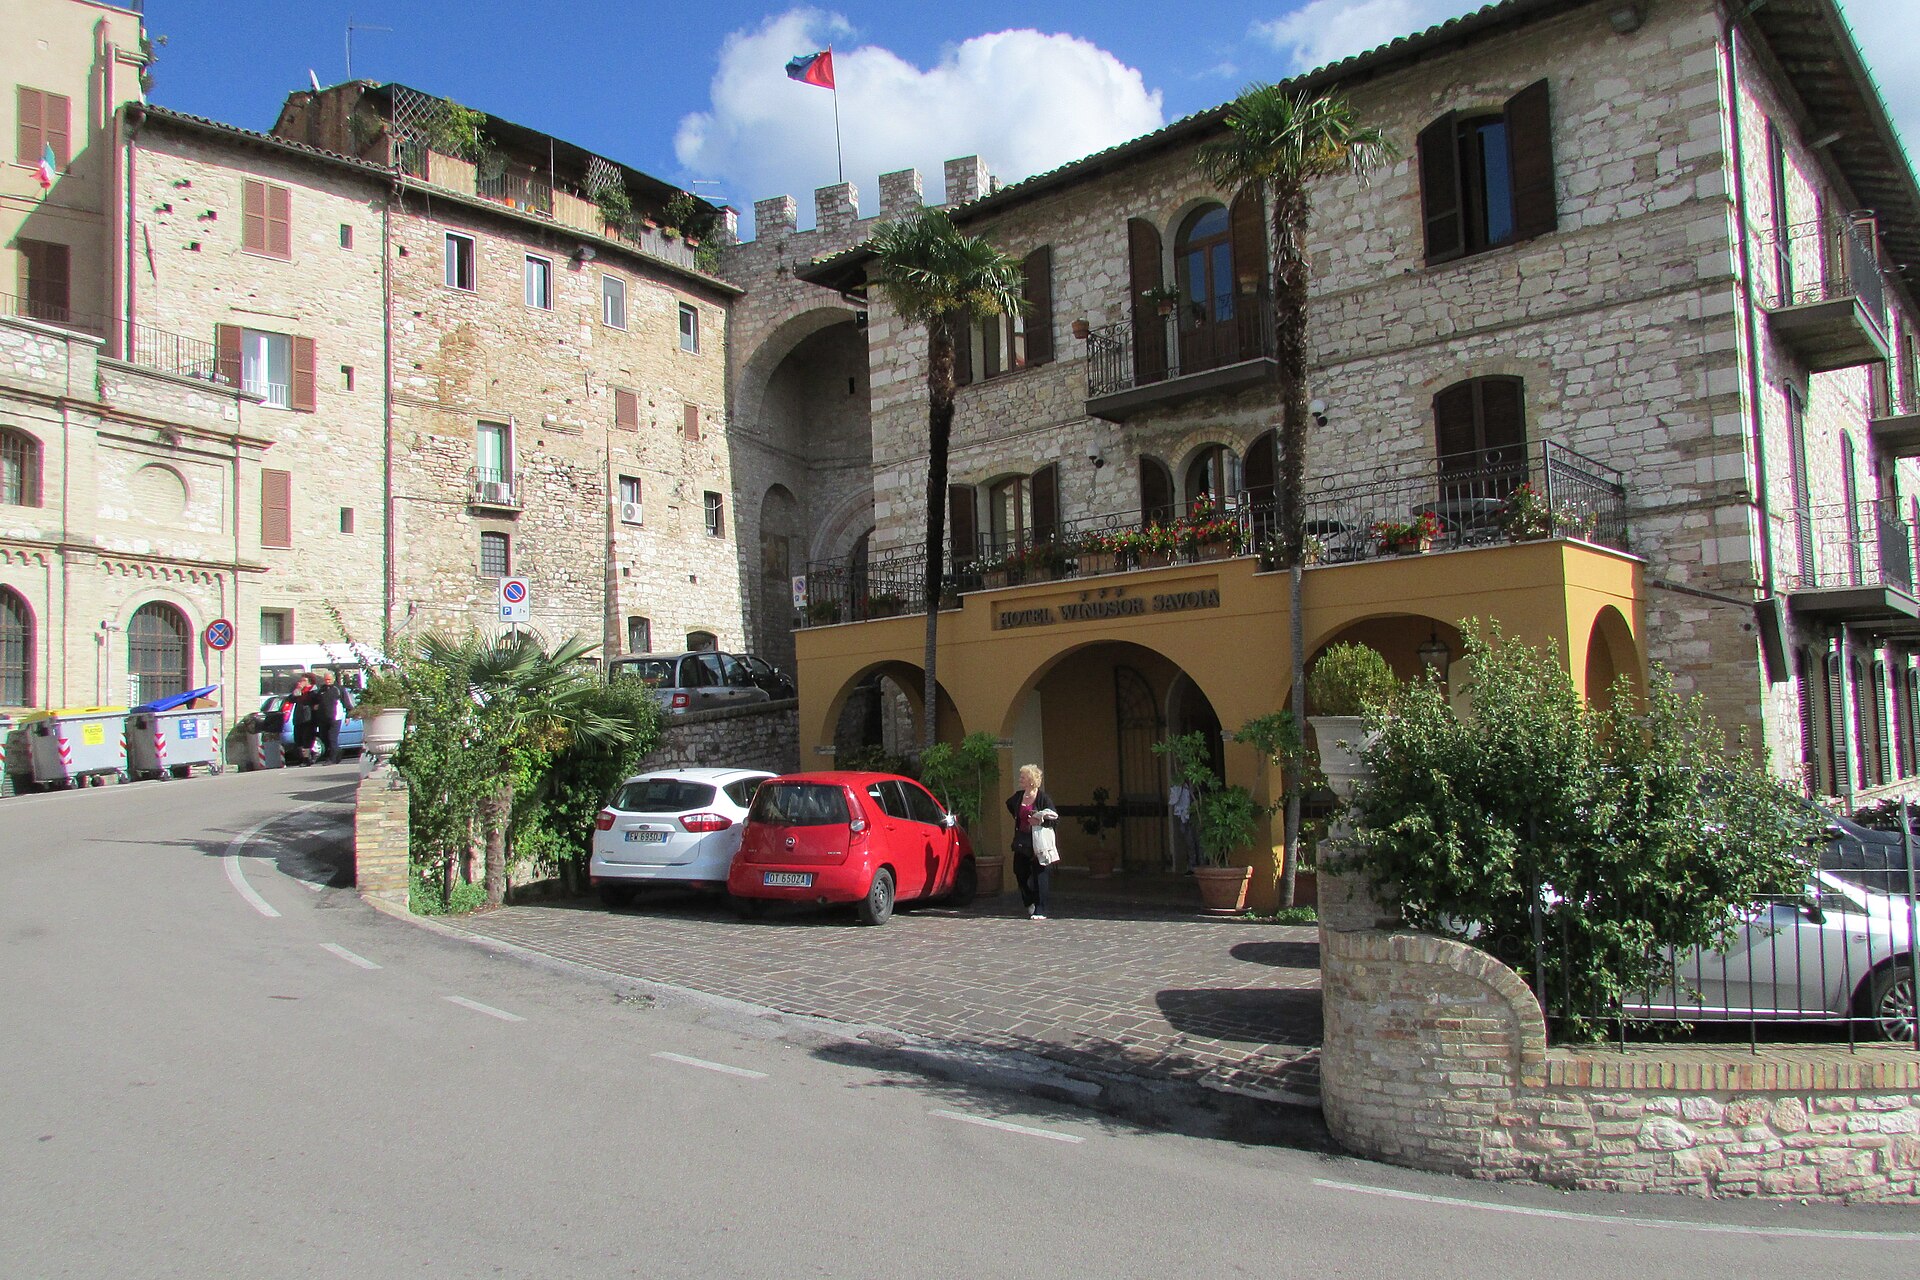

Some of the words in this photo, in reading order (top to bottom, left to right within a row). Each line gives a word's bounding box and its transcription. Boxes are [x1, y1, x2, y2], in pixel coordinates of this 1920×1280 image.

[1000, 608, 1054, 626] HOTEL
[1058, 598, 1145, 620] WINDSOR
[1153, 589, 1220, 611] SAVOIA
